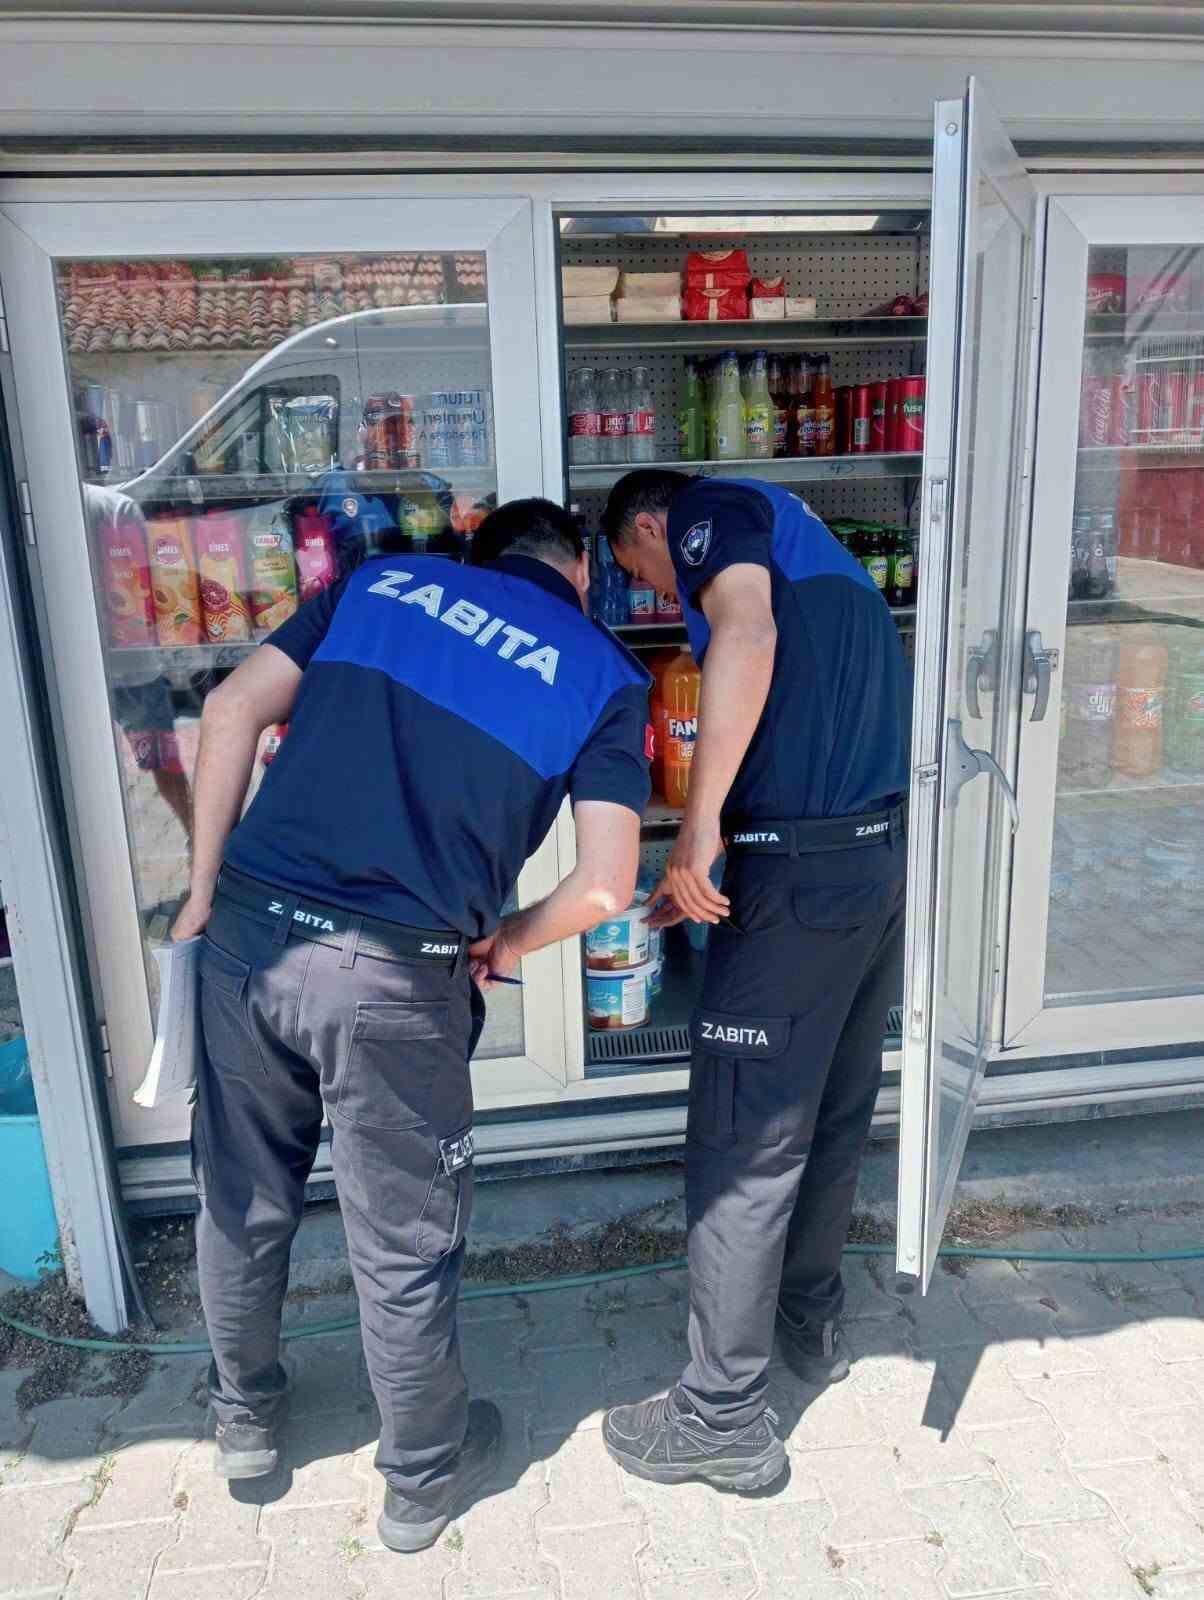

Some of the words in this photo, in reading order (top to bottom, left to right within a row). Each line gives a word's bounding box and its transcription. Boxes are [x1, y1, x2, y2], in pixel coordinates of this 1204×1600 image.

[367, 570, 560, 686] ZABITA
[669, 717, 698, 737] FAN
[733, 832, 780, 843] ZABITA
[855, 821, 889, 837] ZABIT
[267, 900, 334, 932] ZBITA
[420, 943, 459, 955] ZABIT
[701, 1021, 769, 1046] ZABITA
